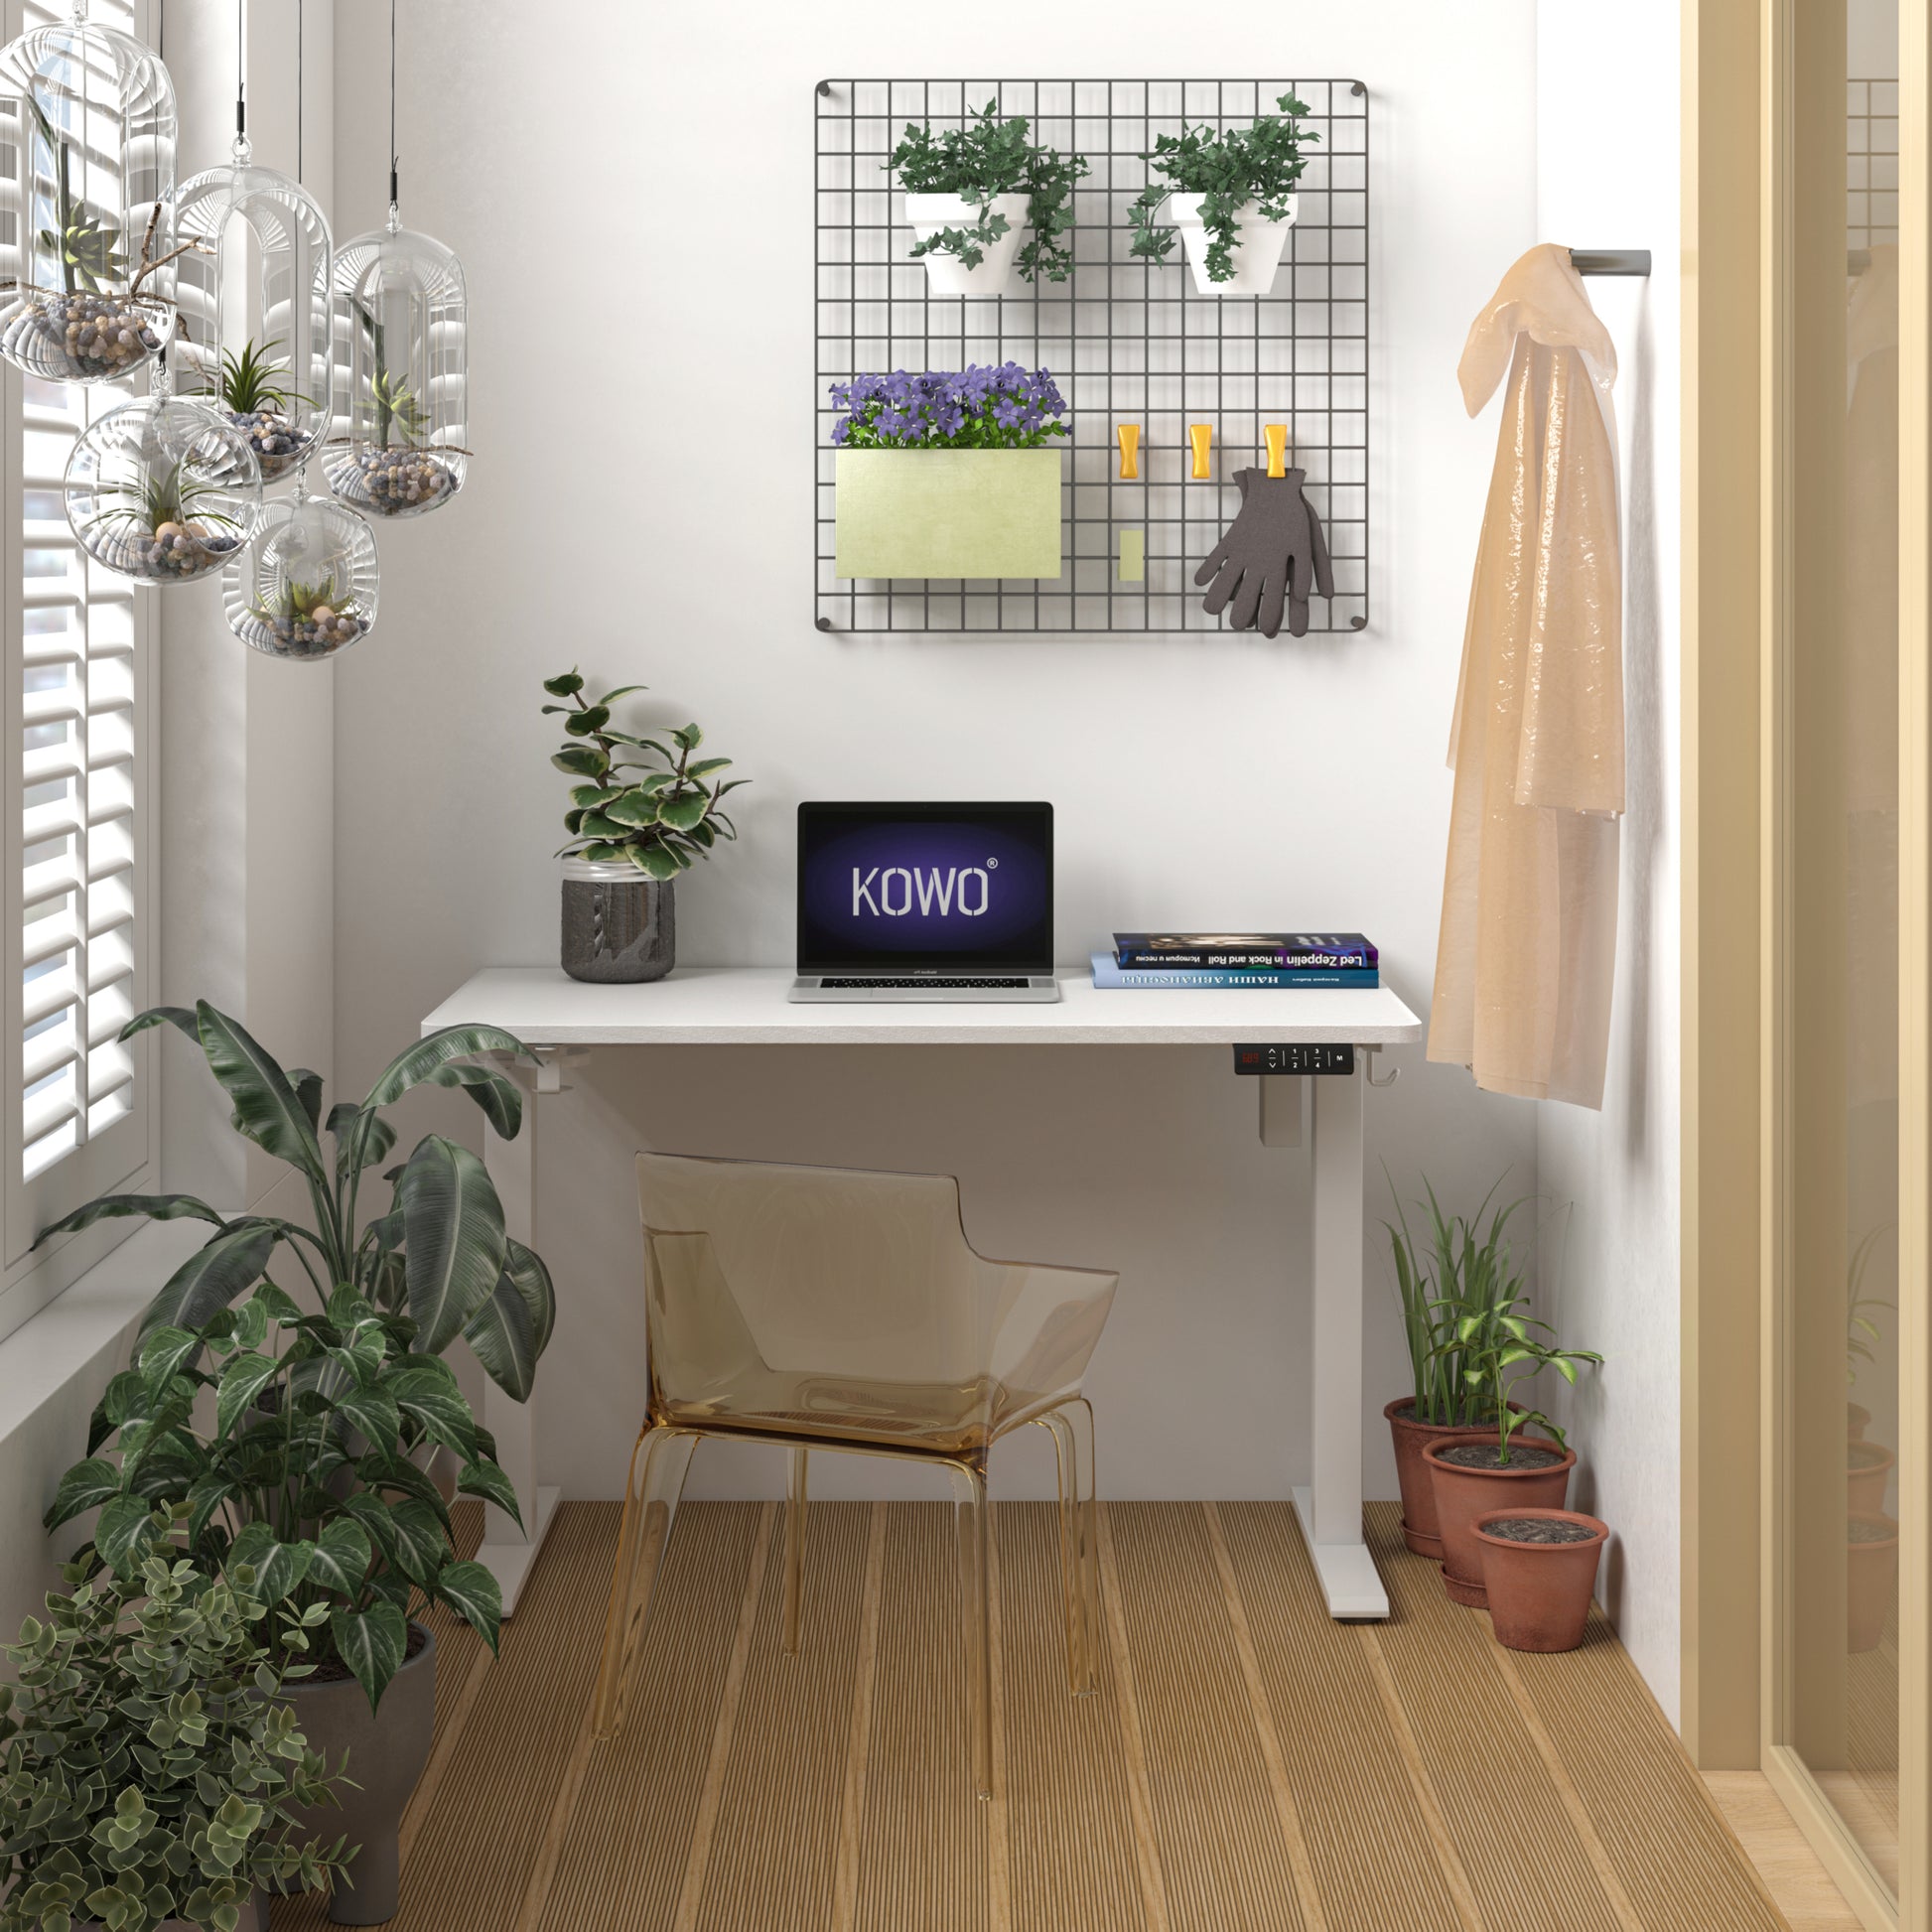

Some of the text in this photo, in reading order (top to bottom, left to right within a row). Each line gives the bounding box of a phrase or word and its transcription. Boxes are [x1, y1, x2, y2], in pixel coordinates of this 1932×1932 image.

[1274, 956, 1283, 965] in
[1287, 954, 1337, 966] Zeppelin
[1340, 955, 1362, 966] Led
